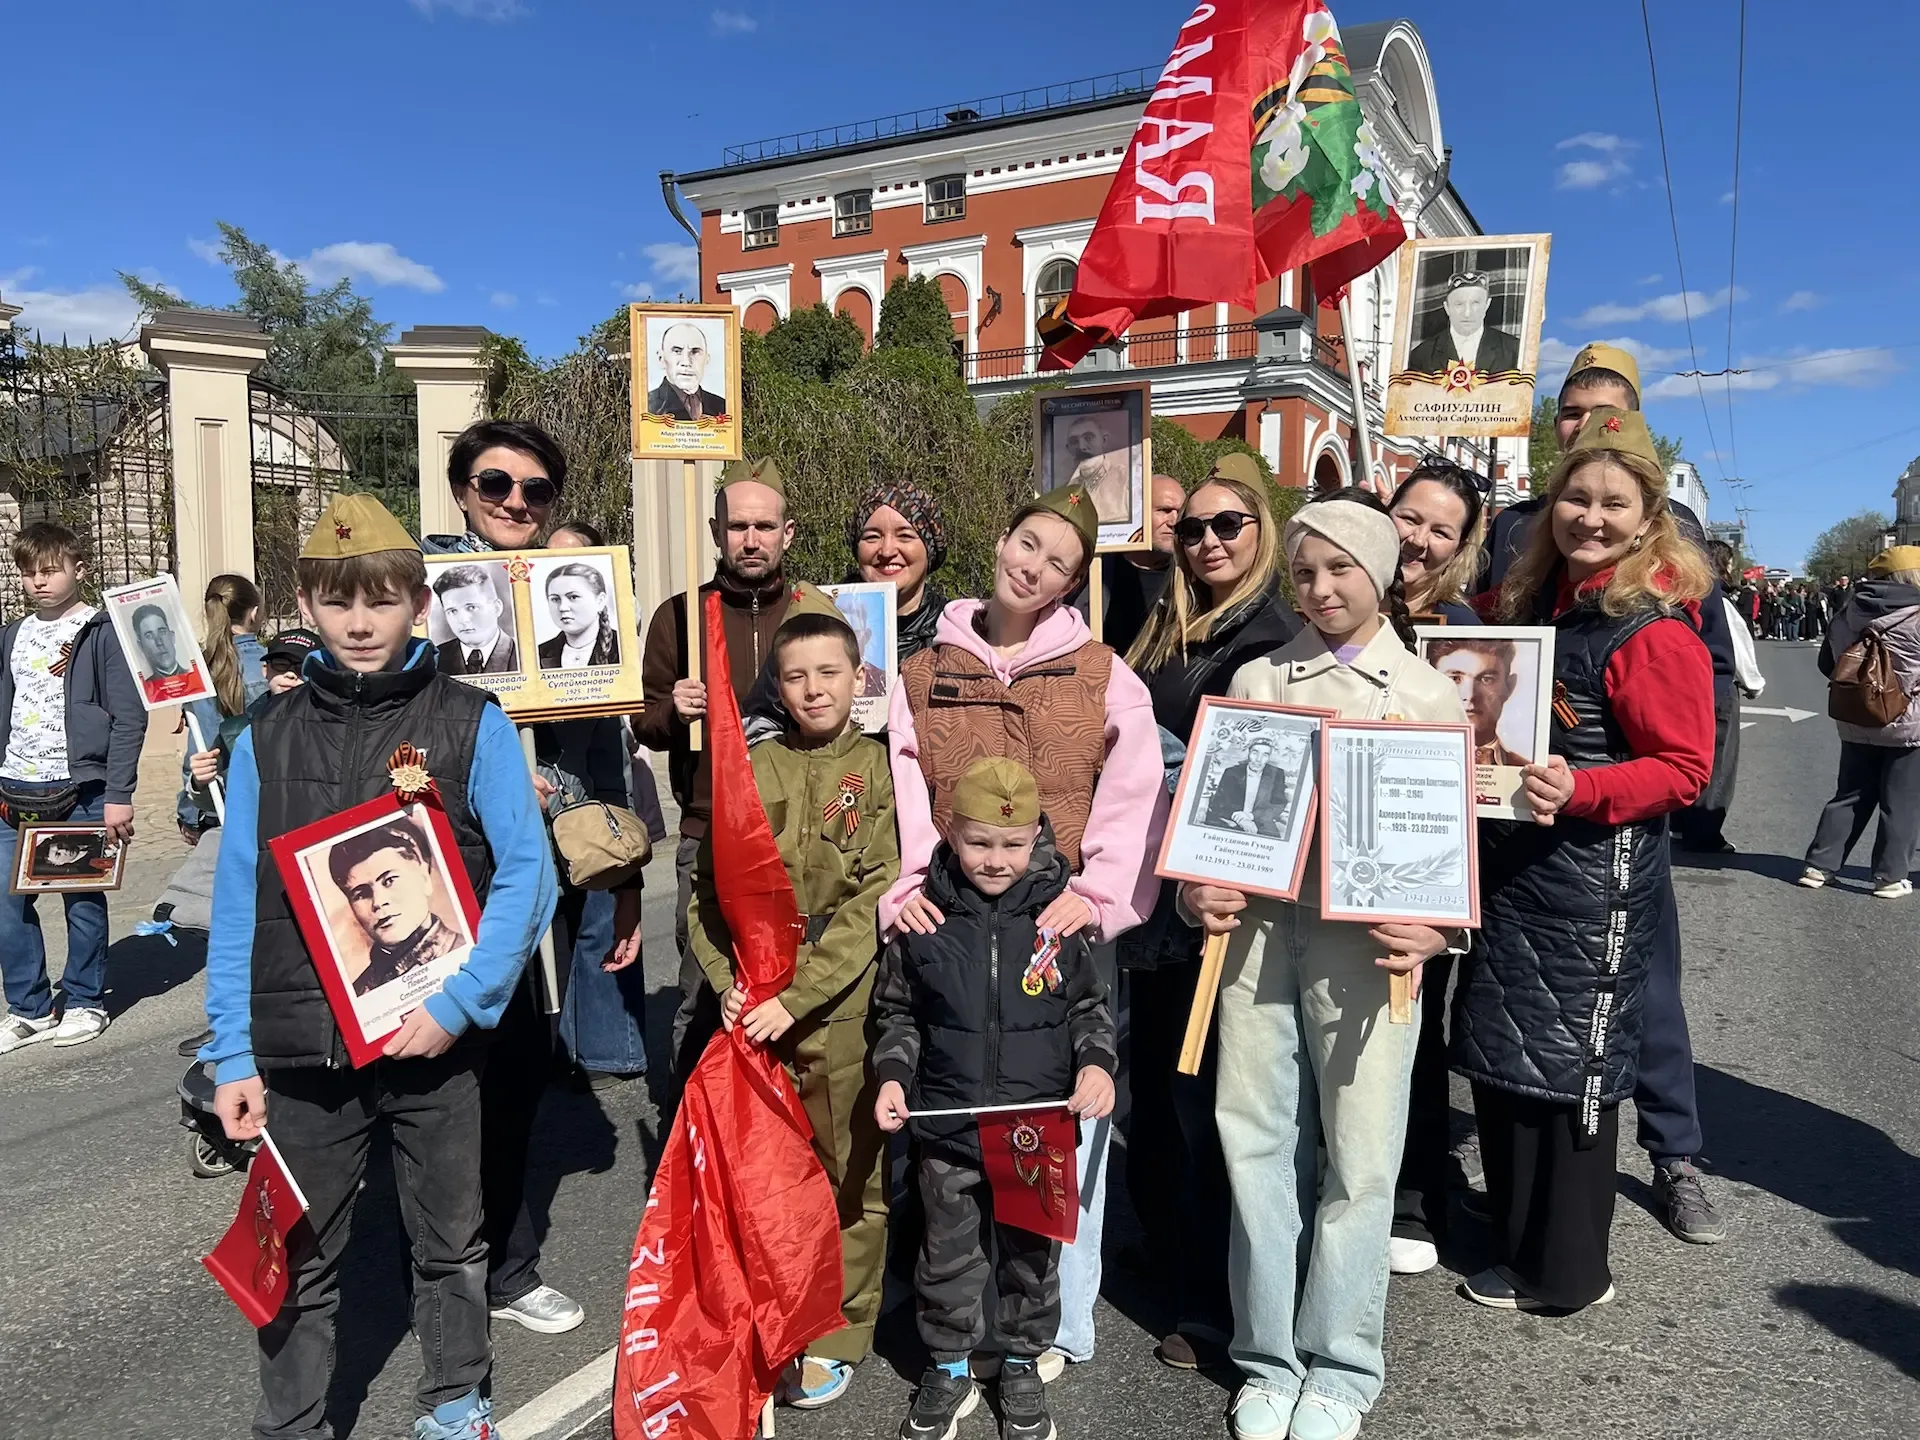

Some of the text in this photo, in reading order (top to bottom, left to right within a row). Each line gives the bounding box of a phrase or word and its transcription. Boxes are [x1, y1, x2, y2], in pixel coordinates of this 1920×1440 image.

[1135, 35, 1216, 226] МАЯ
[1413, 403, 1502, 413] САФИУЛЛИН
[1398, 414, 1518, 423] Ахметсафа Сафиуллович
[480, 675, 528, 686] Шагавали
[540, 671, 588, 681] Ахметова
[548, 677, 615, 689] Сулеймановна
[1250, 840, 1275, 852] Гумар
[1195, 854, 1230, 867] 10.12.1913
[1236, 861, 1274, 874] 23.01.1989
[1619, 851, 1631, 891] CLASSIC
[1404, 893, 1465, 905] 1941-1945
[1608, 910, 1627, 975] BEST CLASSIC
[399, 977, 441, 1001] Степанович
[1594, 992, 1613, 1057] BEST CLASSIC
[1587, 1076, 1602, 1136] BEST CLASSIC
